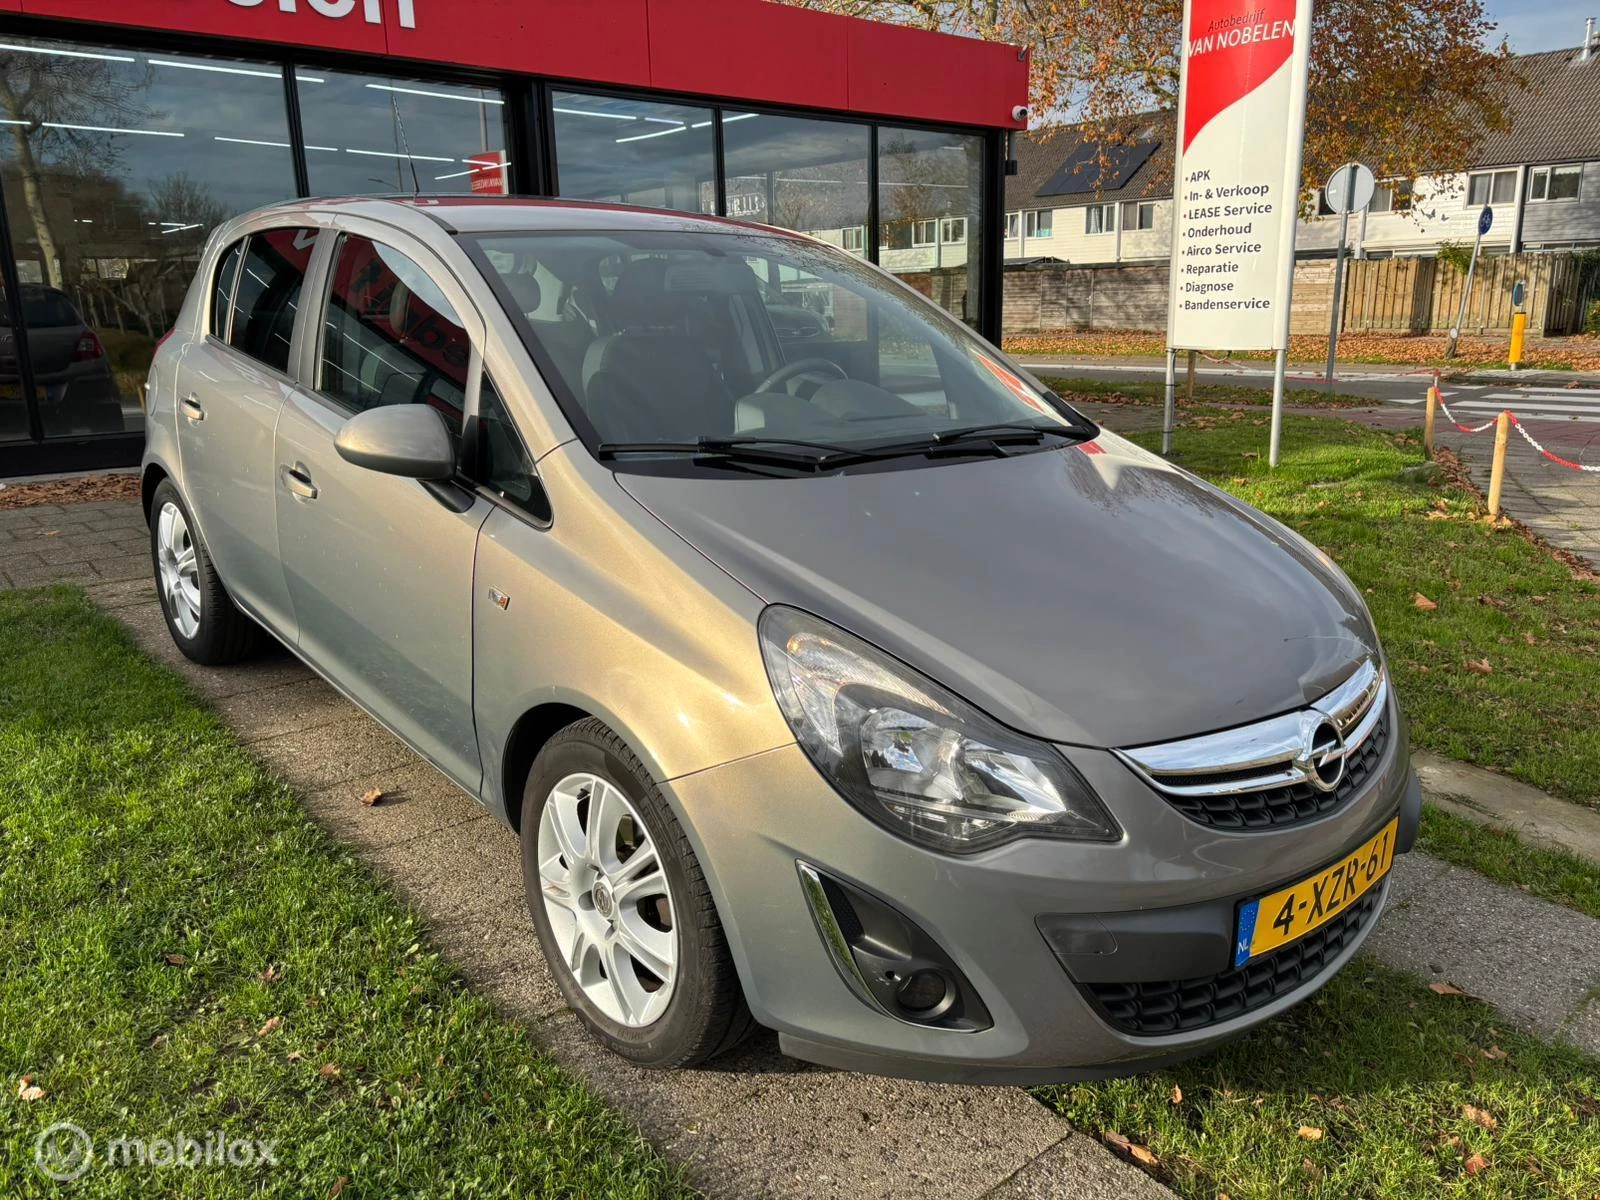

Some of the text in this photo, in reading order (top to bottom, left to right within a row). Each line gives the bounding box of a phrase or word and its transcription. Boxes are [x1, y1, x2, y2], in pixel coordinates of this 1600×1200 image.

[1207, 8, 1266, 32] Autobedrijf
[1187, 18, 1297, 57] VAN NOBELEN
[1190, 169, 1211, 183] APK
[1189, 184, 1270, 201] In- & Verkoop
[1188, 202, 1273, 220] LEASE Service
[1187, 222, 1252, 238] Onderhoud
[1186, 241, 1262, 257] Airco Service
[1186, 261, 1239, 276] Reparatie
[1185, 281, 1234, 294] Diagnose
[1184, 297, 1271, 310] Bandenservice
[1272, 831, 1389, 936] 4-XZR-61
[1237, 938, 1249, 955] NL
